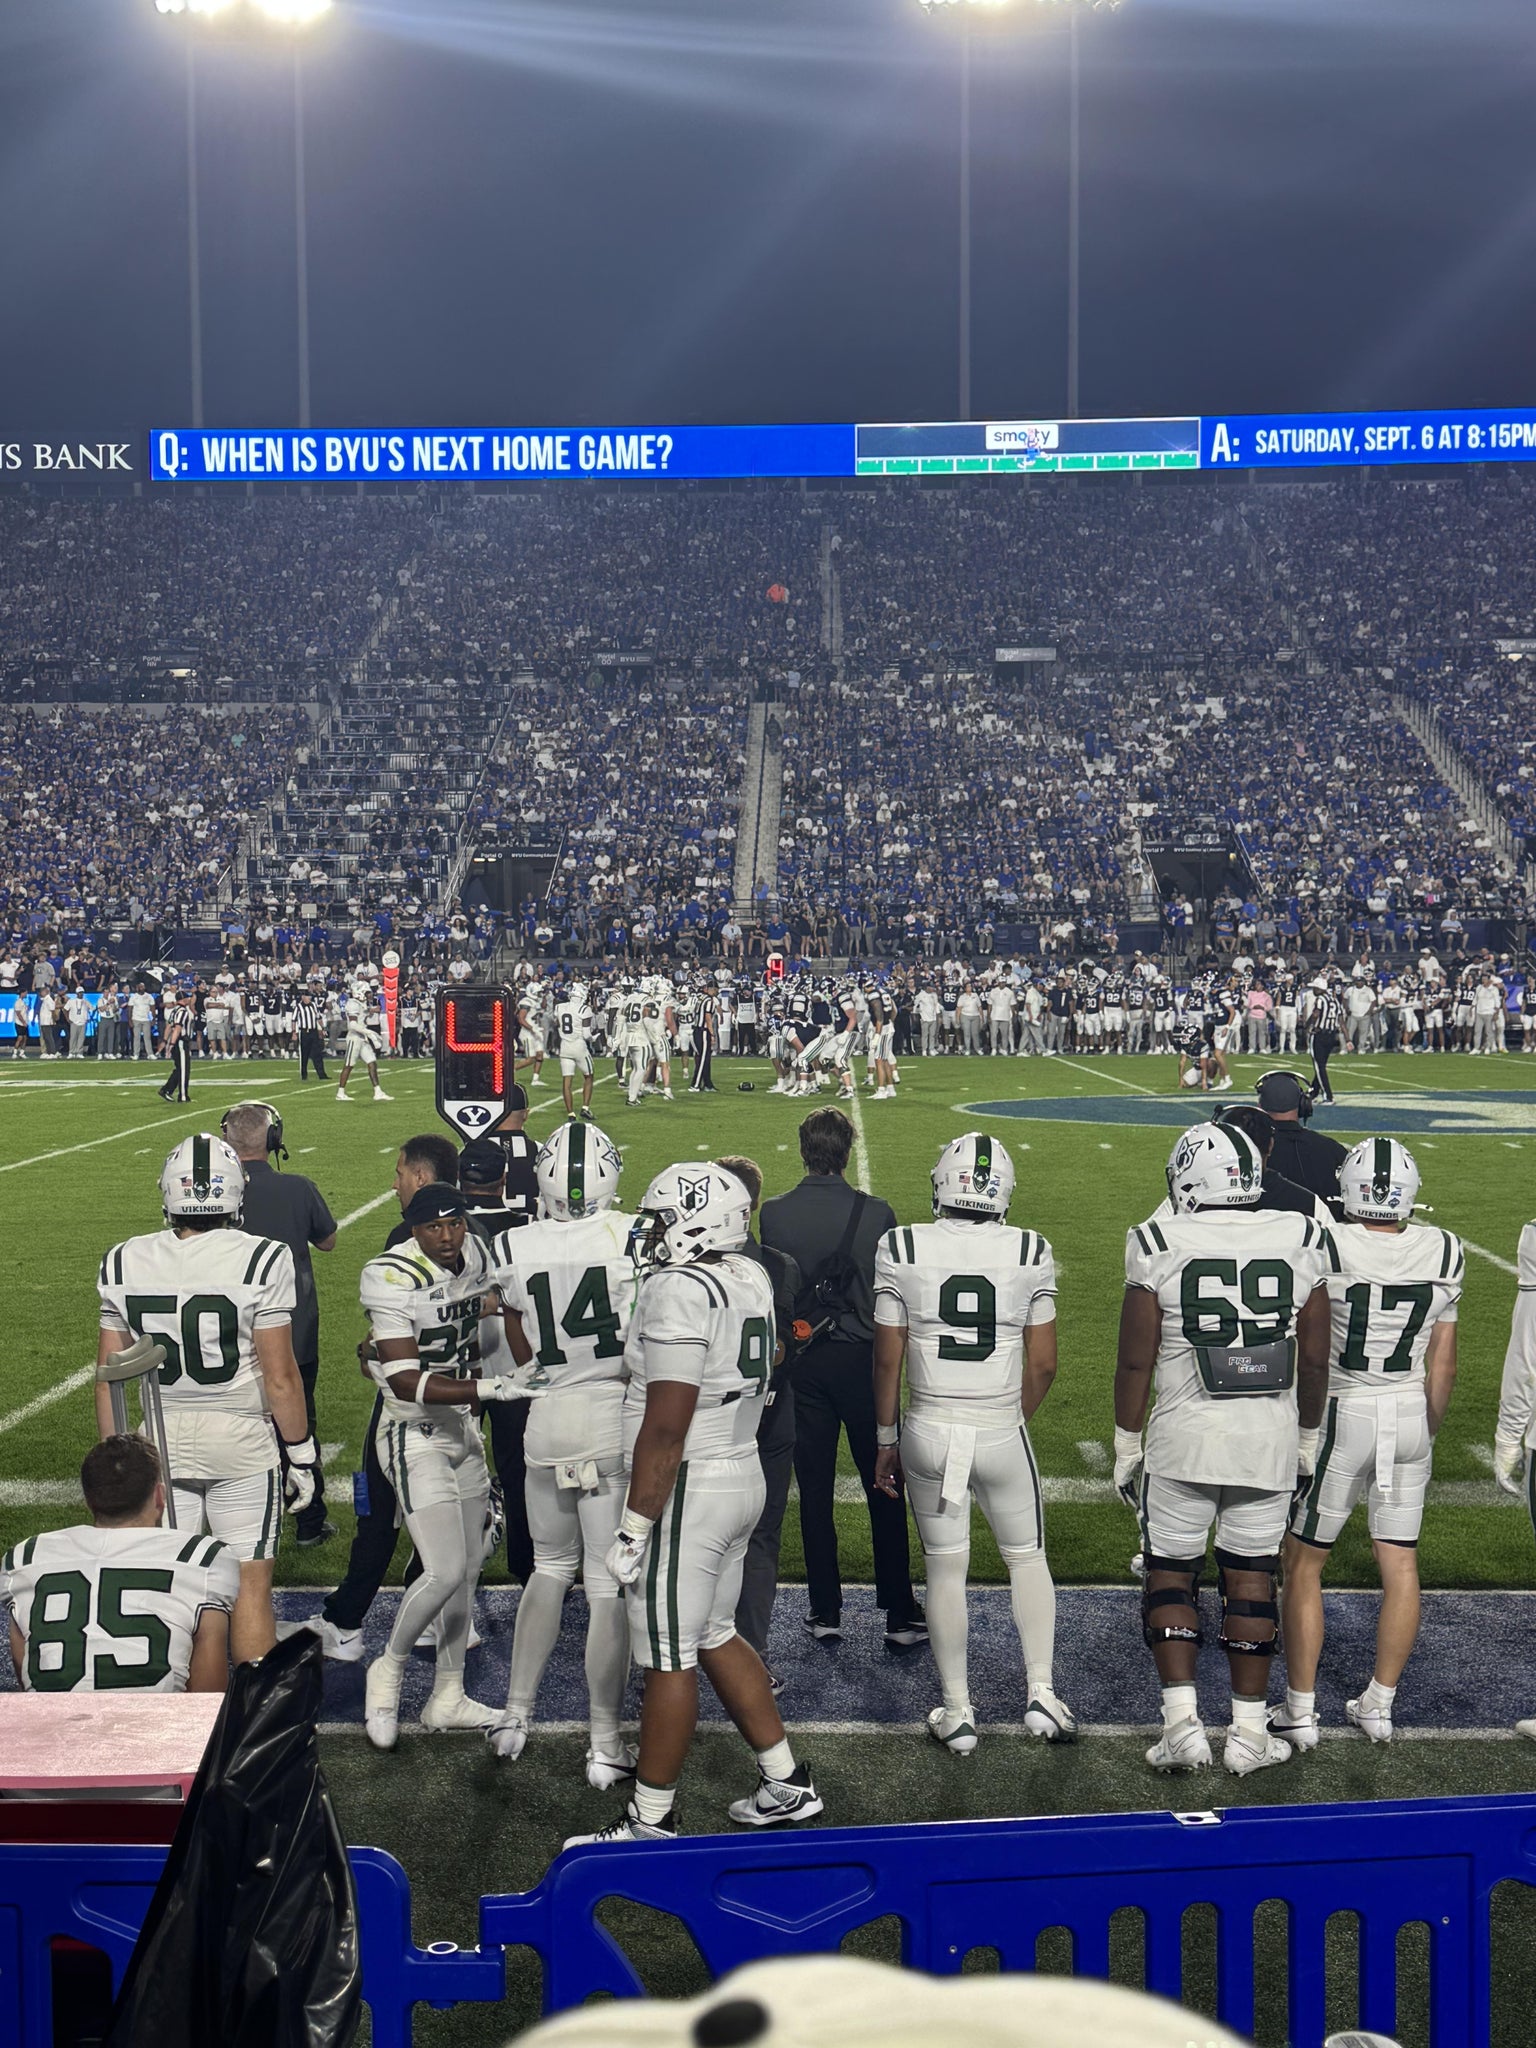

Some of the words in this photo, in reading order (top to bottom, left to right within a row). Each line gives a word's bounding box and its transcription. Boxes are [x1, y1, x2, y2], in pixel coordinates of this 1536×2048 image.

[159, 432, 188, 478] Q:
[202, 437, 284, 473] WHEN
[292, 437, 318, 472] IS
[325, 436, 405, 472] BYU'S
[413, 436, 485, 471] NEXT
[493, 435, 571, 471] HOME
[578, 434, 673, 470] GAME?
[1210, 423, 1240, 463] A:
[1255, 427, 1360, 455] SATURDAY,
[1364, 425, 1417, 451] SEPT.
[1421, 425, 1434, 450] 6
[1438, 424, 1464, 449] AT
[1467, 422, 1536, 449] 8:15PM
[33, 444, 133, 470] BANK
[561, 1013, 573, 1034] 8
[624, 1002, 641, 1023] 46
[446, 999, 503, 1094] 4
[461, 1107, 487, 1125] Y
[181, 1205, 224, 1213] VIKINGS
[955, 1198, 996, 1211] VIKINGS
[1357, 1209, 1399, 1218] VIKINGS
[526, 1265, 625, 1366] 14
[938, 1274, 996, 1362] 9
[1180, 1258, 1294, 1348] 69
[125, 1294, 240, 1385] 50
[1339, 1283, 1433, 1372] 17
[1228, 1356, 1252, 1366] PRO
[1237, 1364, 1268, 1374] GEAR
[27, 1567, 175, 1692] 85
